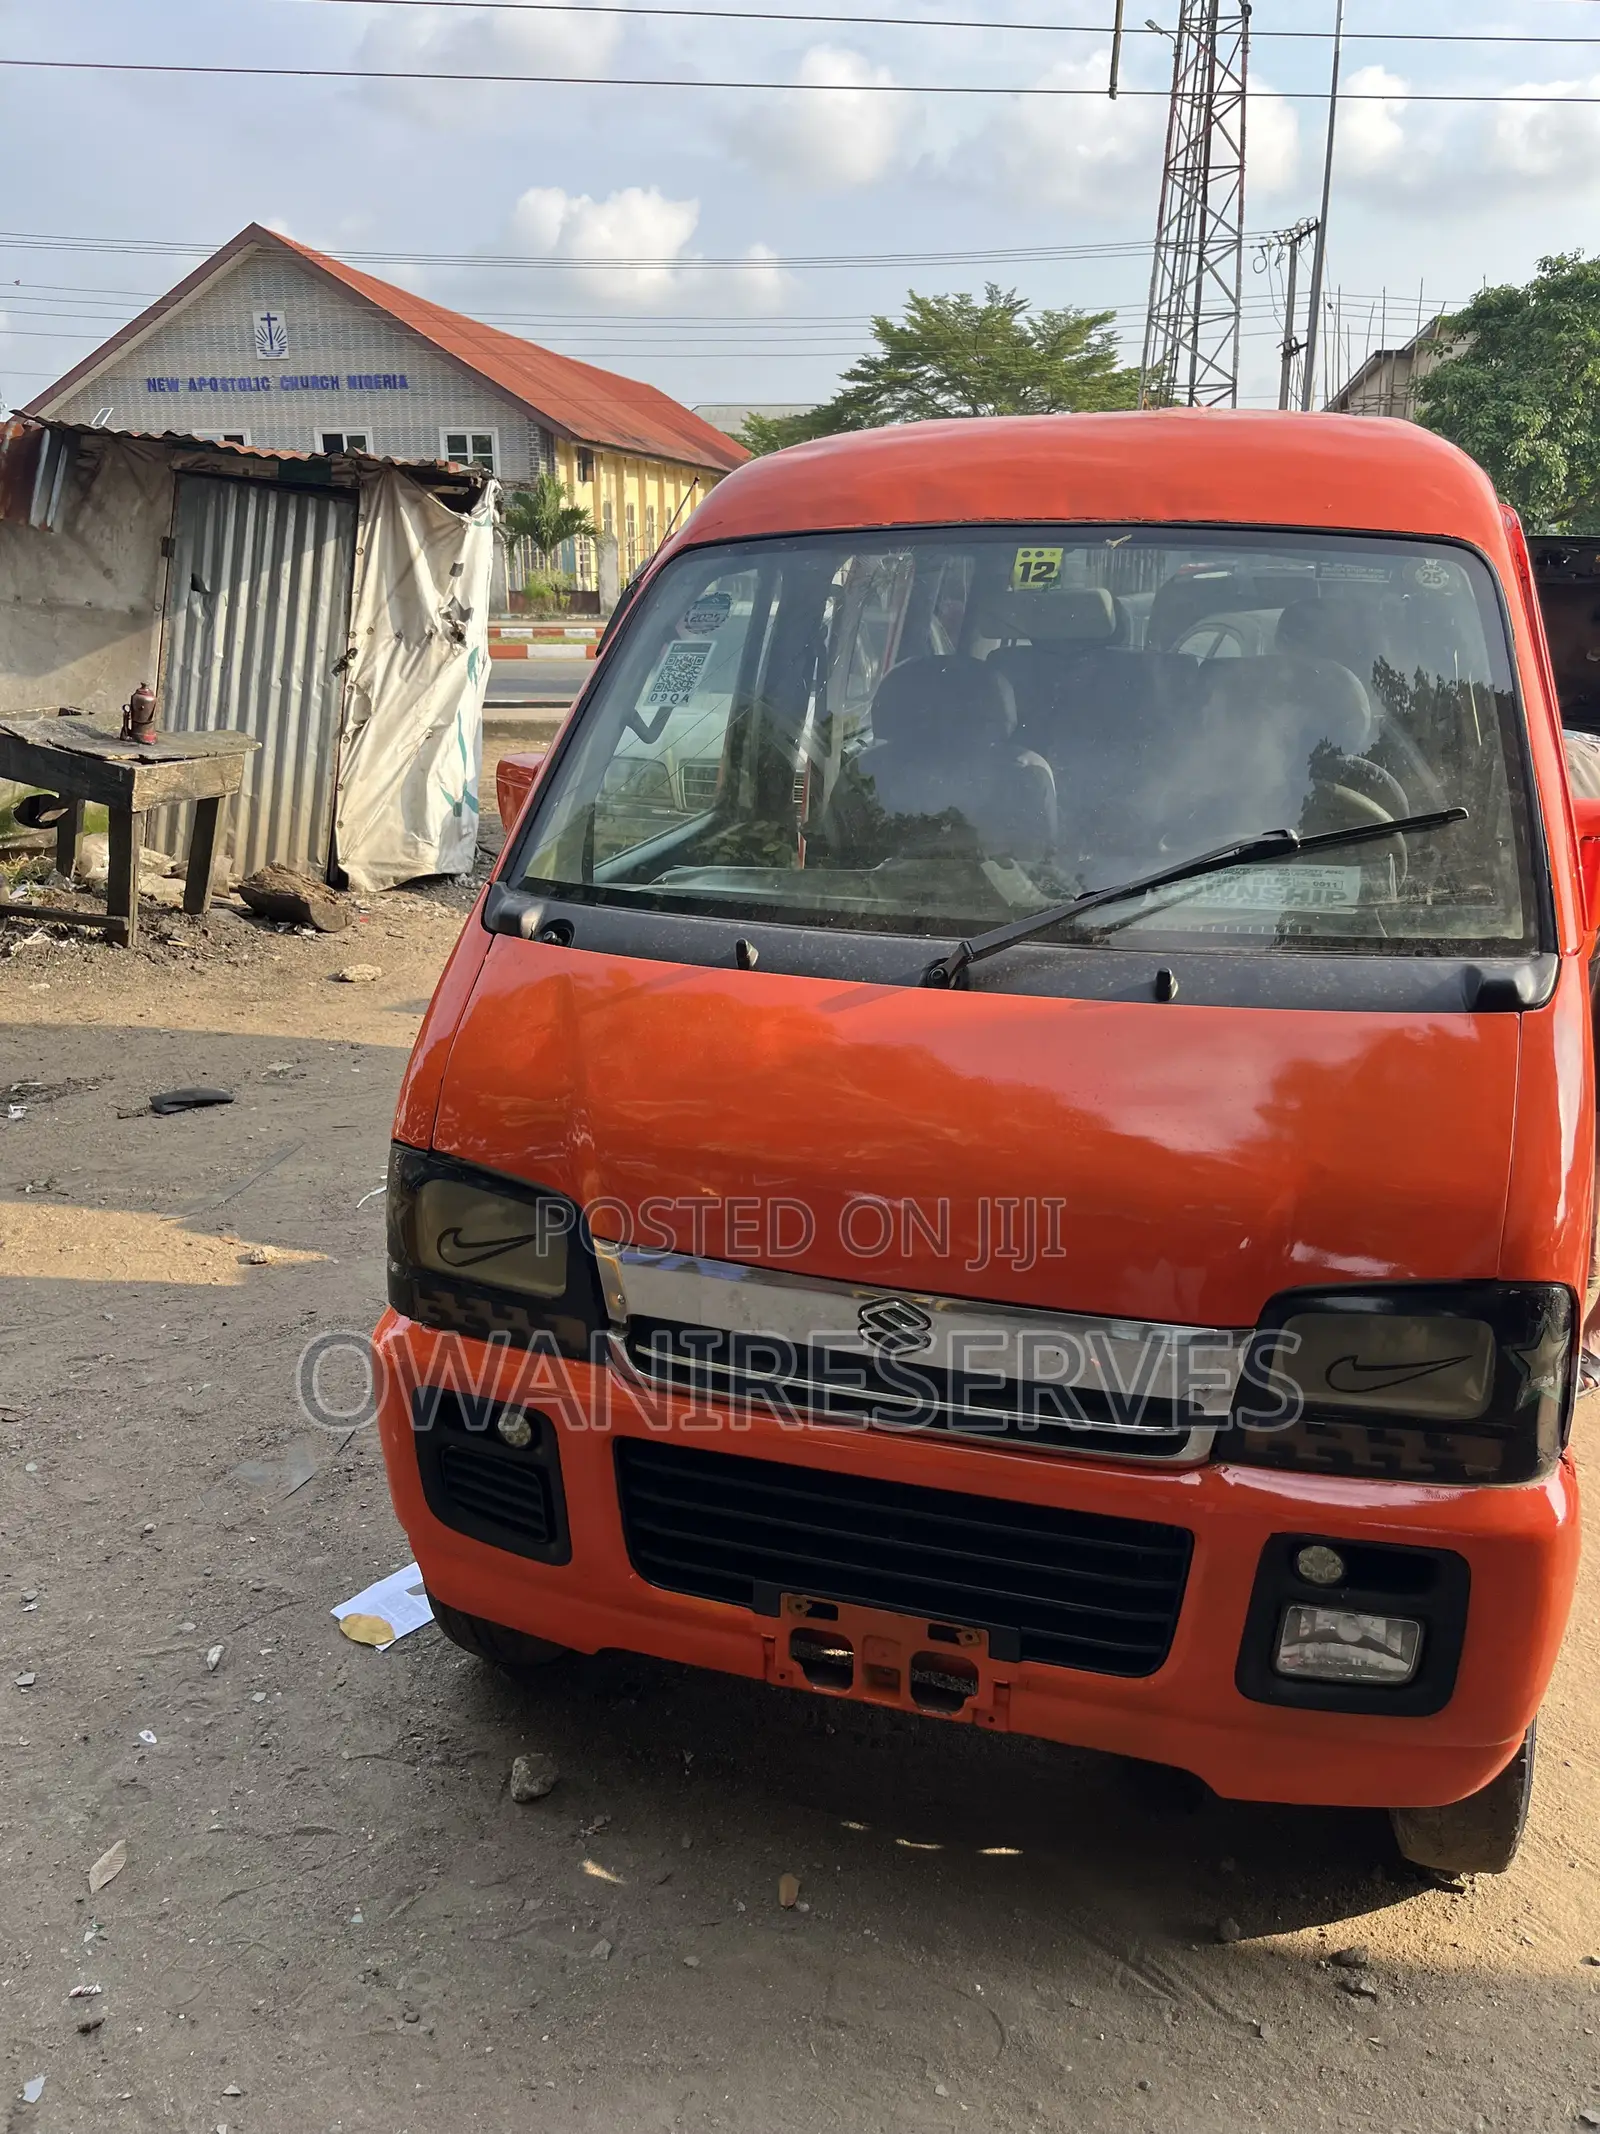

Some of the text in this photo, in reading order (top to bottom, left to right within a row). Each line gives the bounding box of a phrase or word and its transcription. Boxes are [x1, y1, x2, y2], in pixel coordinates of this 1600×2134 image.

[147, 374, 409, 392] NEW APOSTOLIC CHURCH NIGERIA
[1019, 562, 1056, 582] 12
[1422, 571, 1442, 584] 25
[650, 694, 690, 704] 09QA
